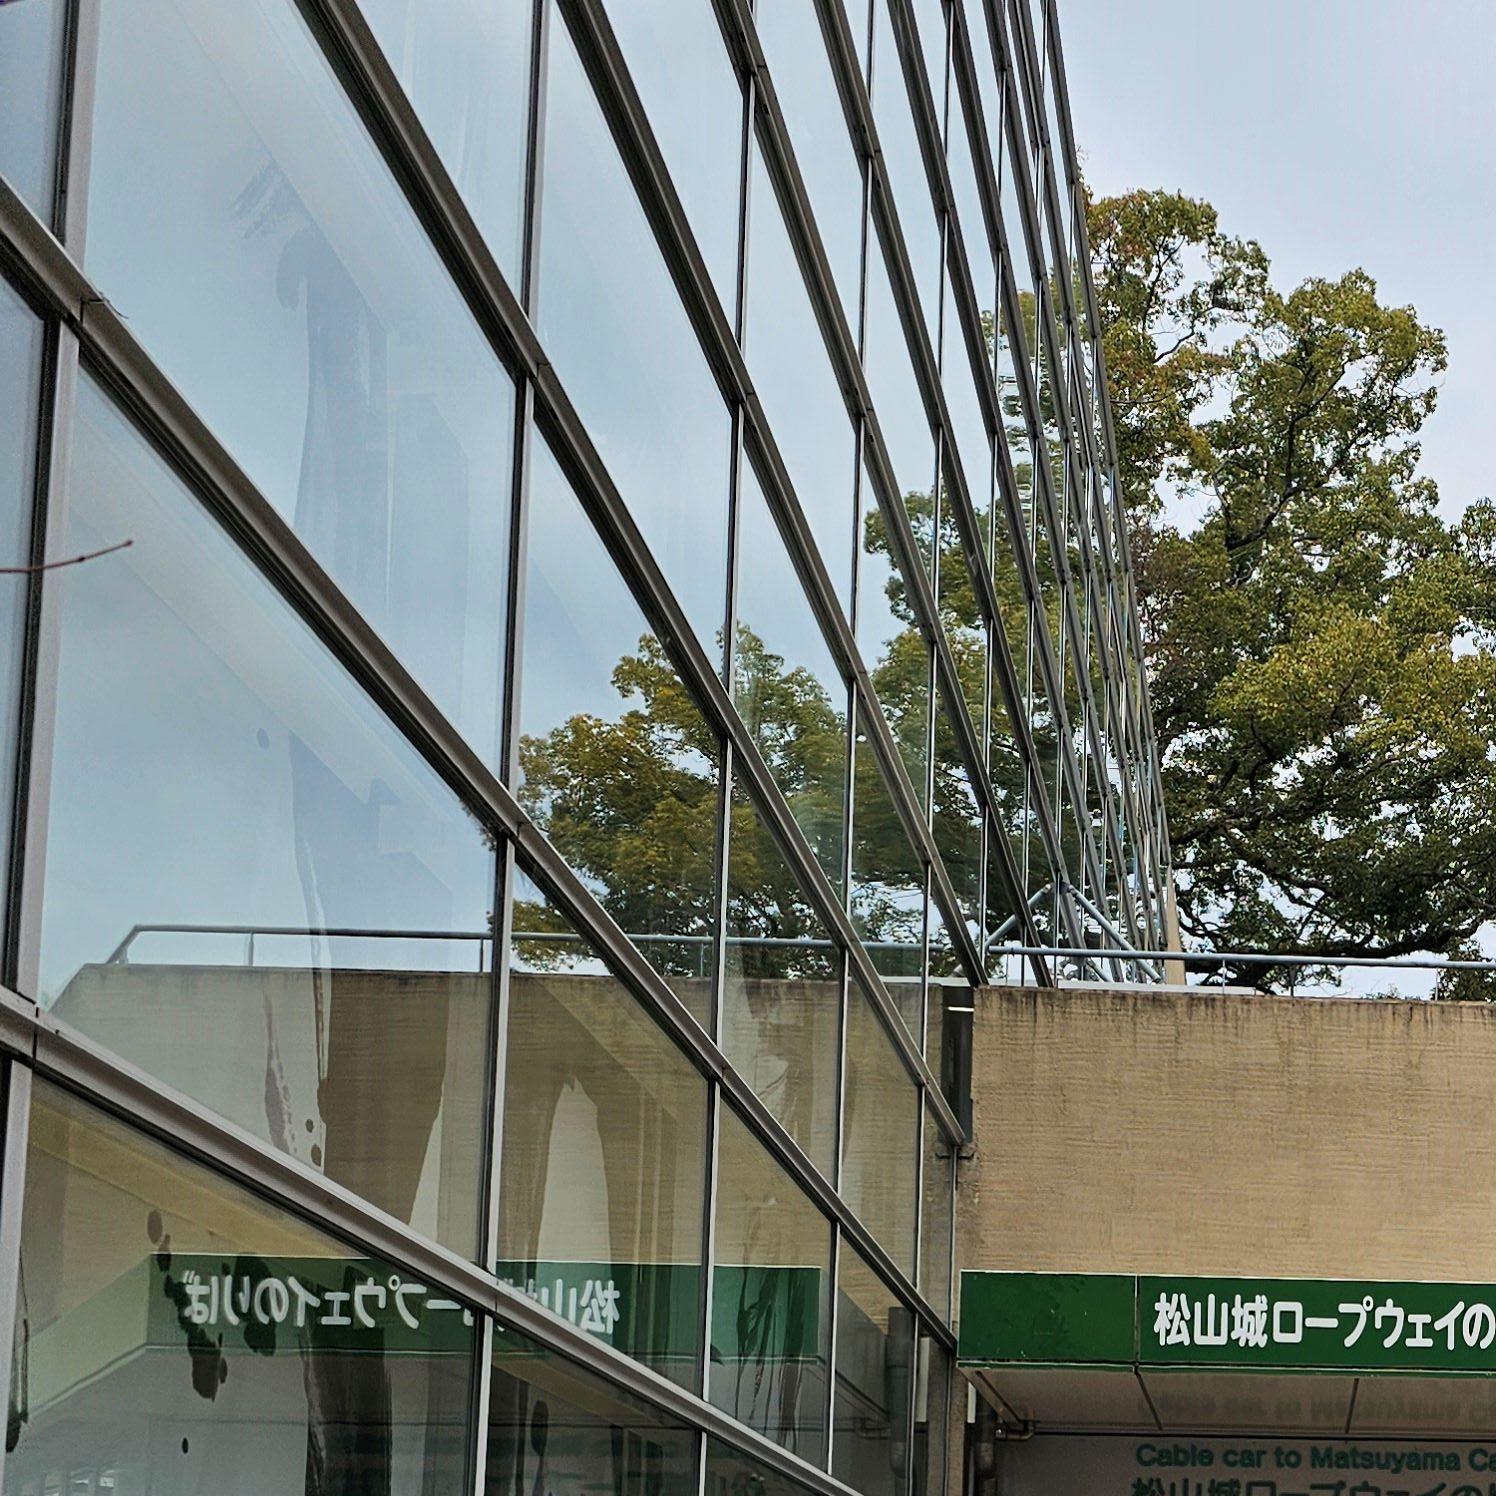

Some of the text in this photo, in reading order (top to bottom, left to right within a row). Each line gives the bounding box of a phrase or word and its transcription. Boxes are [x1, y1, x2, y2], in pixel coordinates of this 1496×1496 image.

[1136, 1443, 1214, 1468] Cable
[1221, 1448, 1267, 1468] car
[1274, 1447, 1303, 1469] to
[1310, 1447, 1461, 1474] Matsuyama
